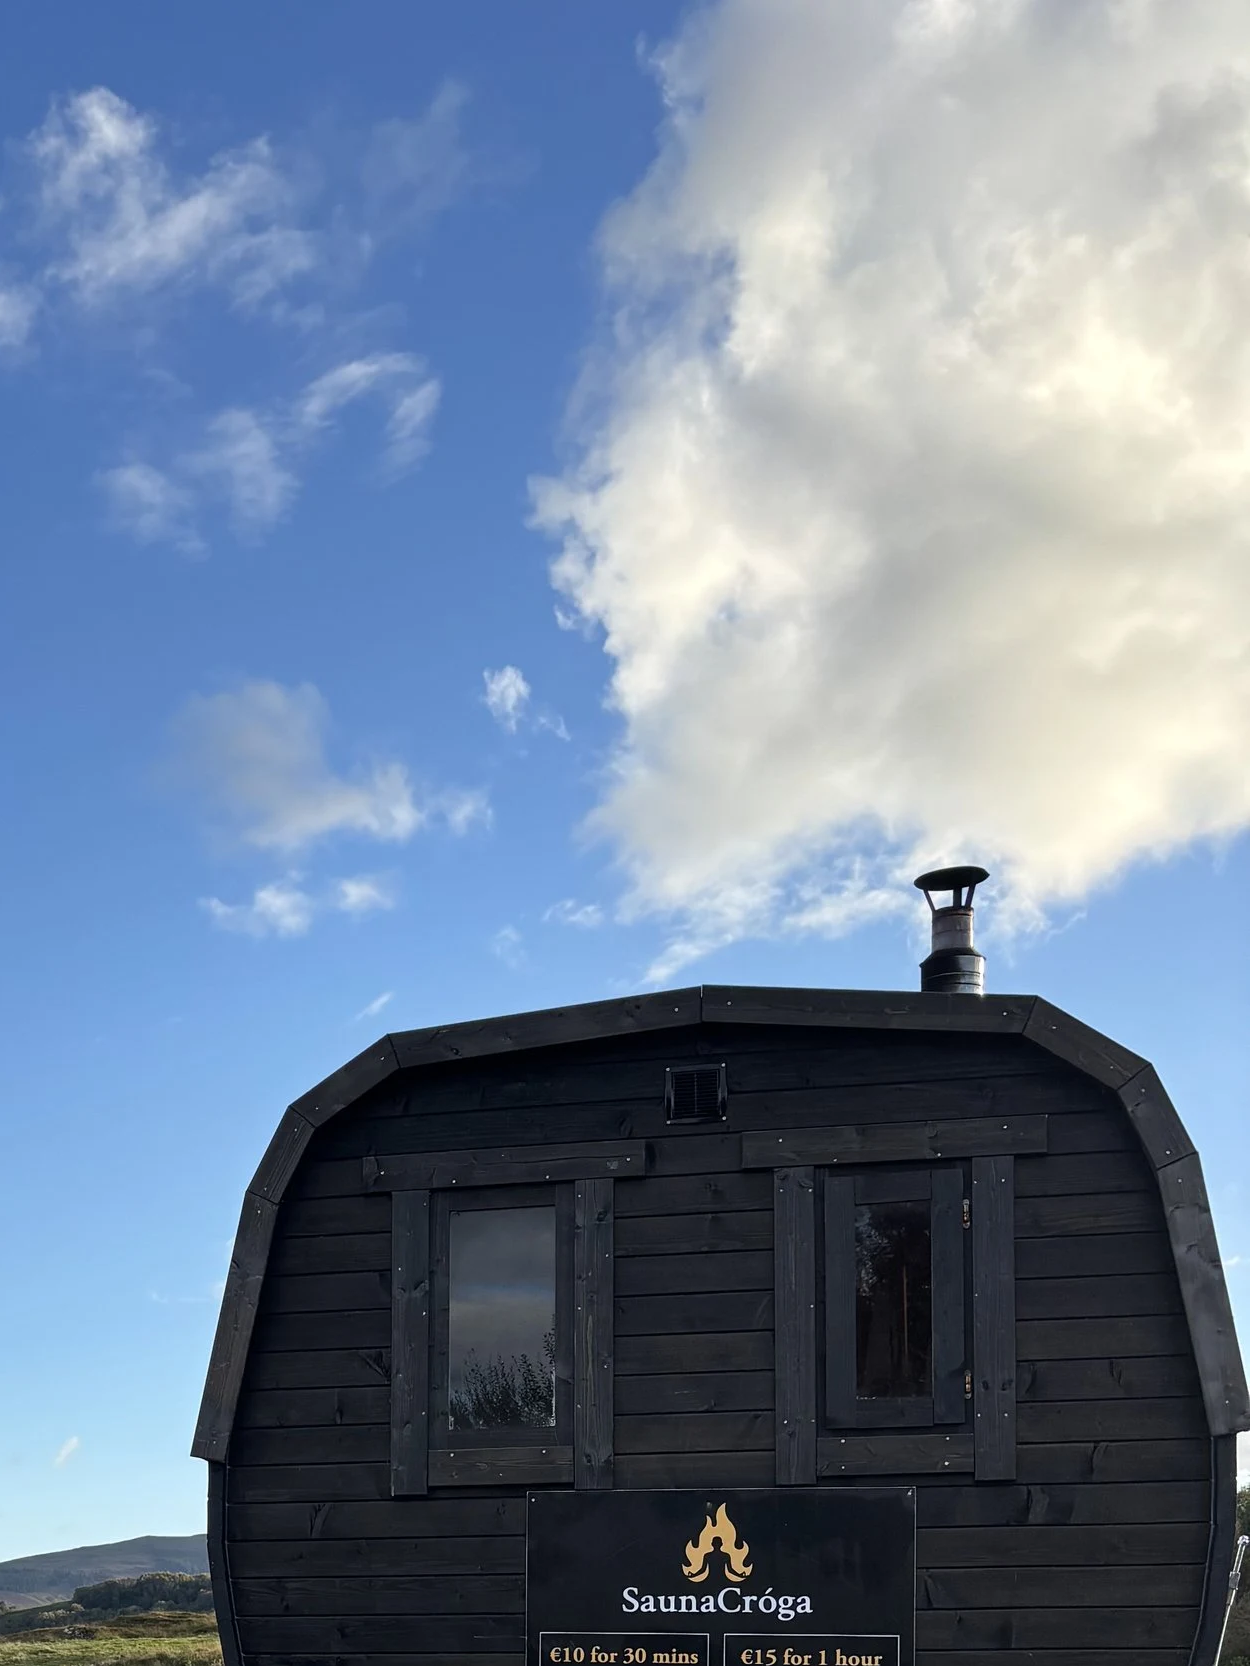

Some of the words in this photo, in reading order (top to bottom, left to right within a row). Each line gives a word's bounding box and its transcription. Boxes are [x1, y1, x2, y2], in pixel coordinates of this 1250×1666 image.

[622, 1587, 813, 1621] SaunaCróga
[550, 1647, 585, 1663] €10
[590, 1646, 618, 1663] for
[623, 1648, 647, 1664] 30
[652, 1648, 699, 1664] mins
[740, 1648, 777, 1666] €15
[783, 1648, 812, 1666] for
[818, 1650, 828, 1666] 1
[835, 1648, 882, 1666] hour
